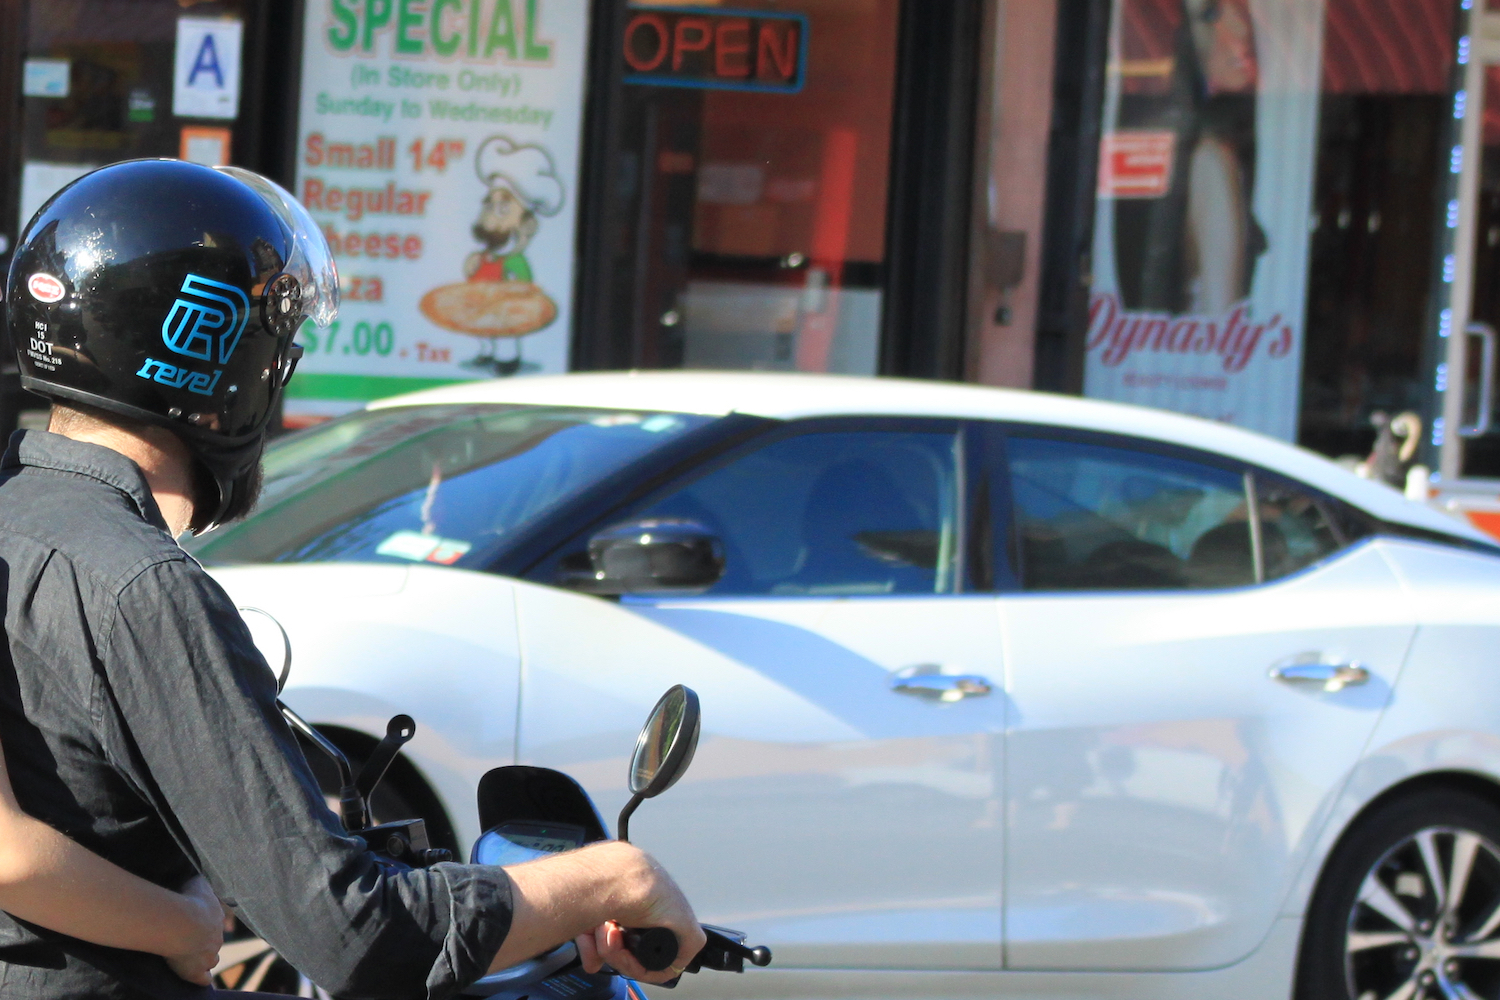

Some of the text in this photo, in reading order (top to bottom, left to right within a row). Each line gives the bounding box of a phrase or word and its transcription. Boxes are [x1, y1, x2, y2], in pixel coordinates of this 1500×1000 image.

[325, 0, 553, 63] SPECIAL
[623, 14, 799, 79] OPEN
[186, 33, 224, 88] A
[387, 64, 451, 89] Store
[316, 92, 555, 130] Sunday to Wednesday
[305, 131, 397, 170] Small
[304, 178, 432, 221] Regular
[323, 223, 422, 260] heese
[30, 337, 53, 355] DOT
[136, 357, 223, 396] revel
